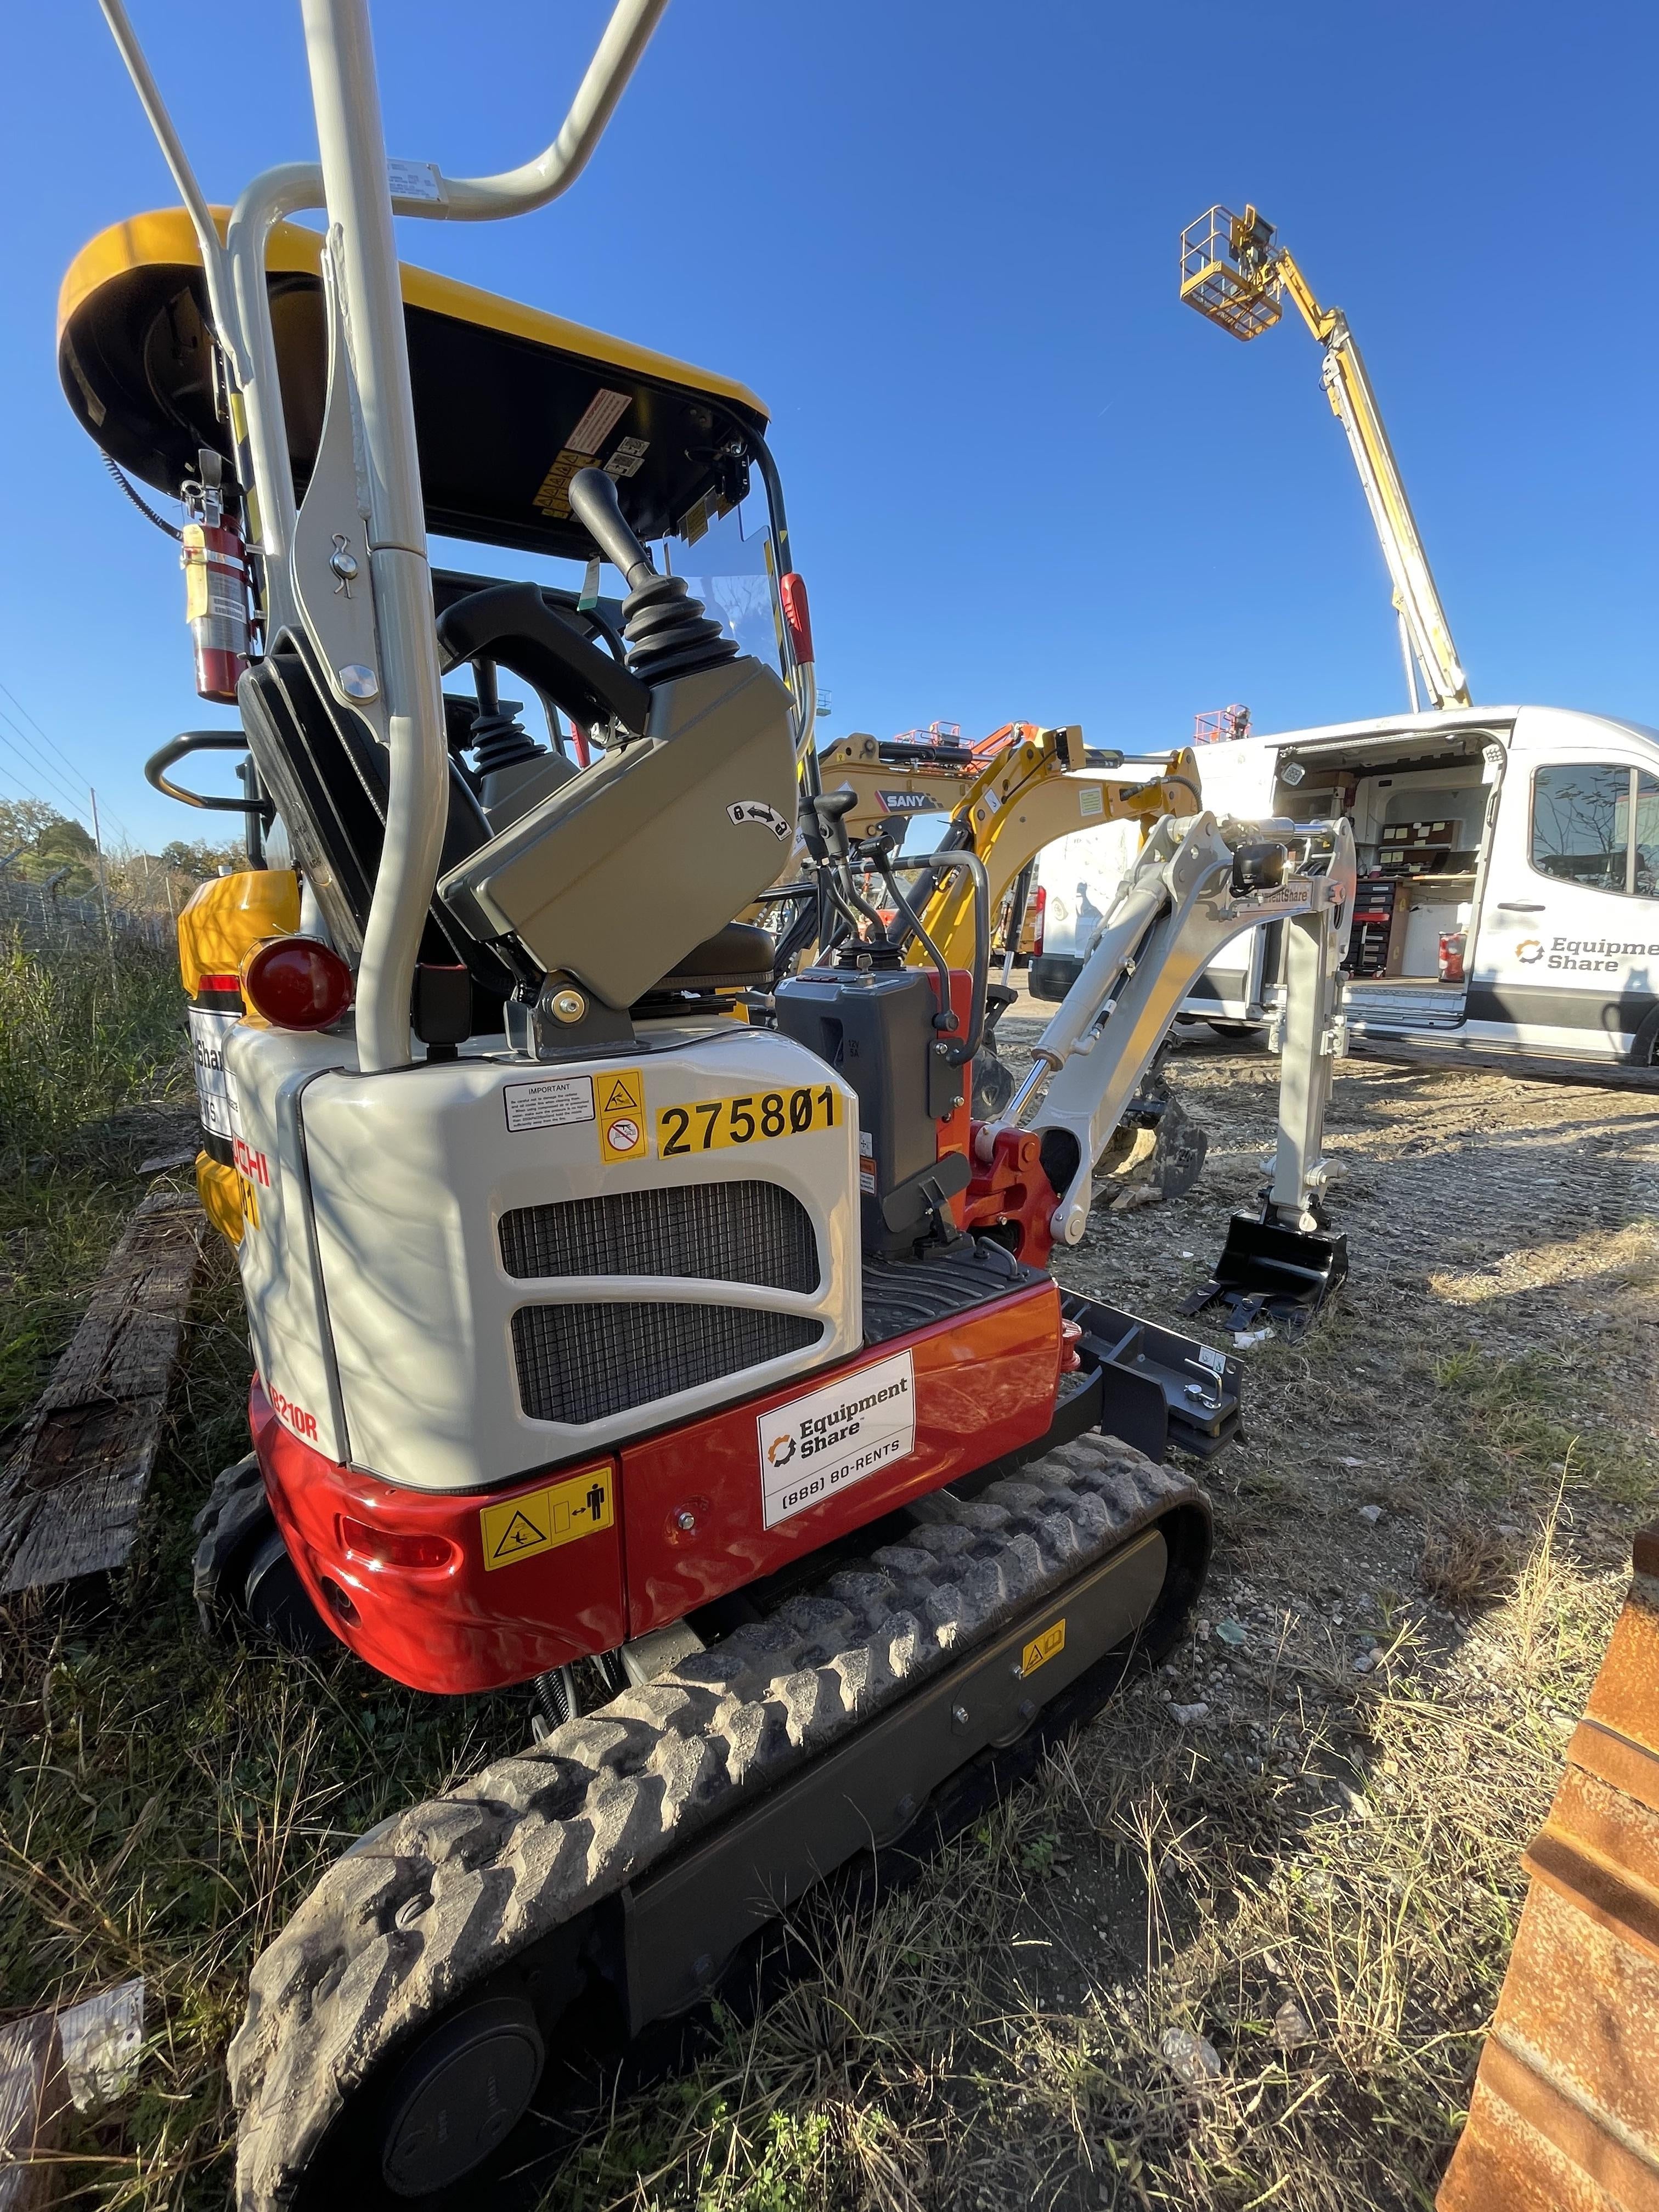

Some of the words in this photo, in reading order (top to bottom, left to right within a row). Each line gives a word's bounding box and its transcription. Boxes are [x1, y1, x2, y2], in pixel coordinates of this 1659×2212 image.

[887, 795, 925, 807] SANY
[1548, 955, 1618, 972] Share
[528, 1084, 571, 1095] IMPORTANT
[661, 1085, 833, 1156] 275801
[799, 1377, 908, 1440] Equipment
[801, 1421, 860, 1459] Share
[782, 1477, 824, 1509] (888)
[830, 1440, 900, 1483] 80-RENTS
